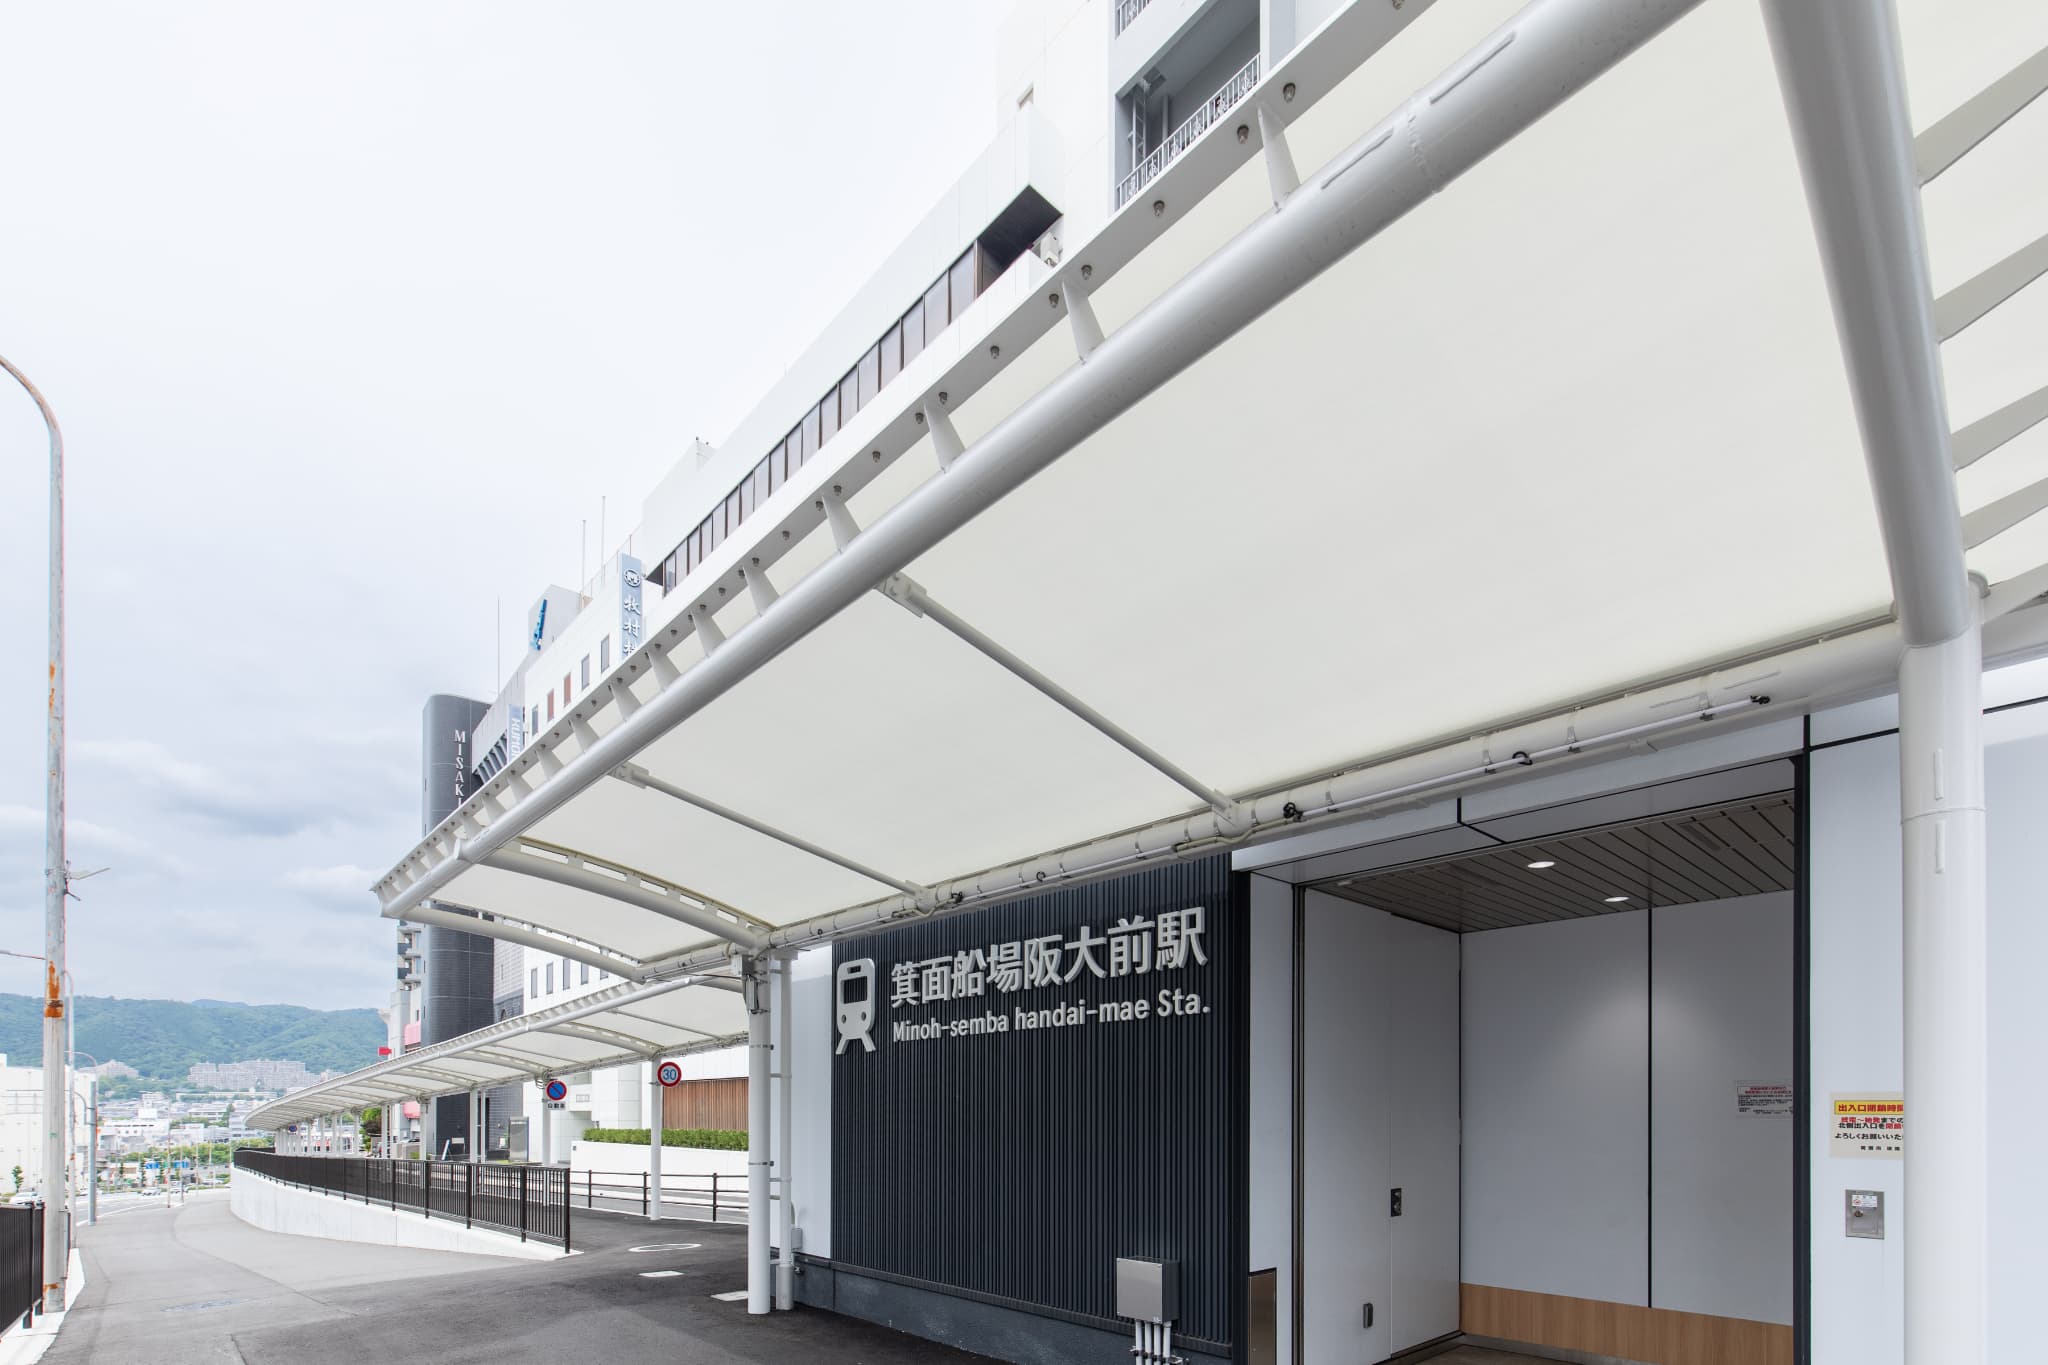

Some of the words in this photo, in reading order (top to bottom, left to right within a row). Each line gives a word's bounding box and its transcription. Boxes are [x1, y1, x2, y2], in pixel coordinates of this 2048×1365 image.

[890, 906, 1208, 1009] 箕面船場阪大前駅
[893, 1009, 1009, 1043] Minoh-semba
[1015, 995, 1149, 1032] handai-mae
[1157, 988, 1212, 1018] Sta.
[662, 1068, 677, 1081] 30
[1835, 1132, 1904, 1140] よろしくお願いいた
